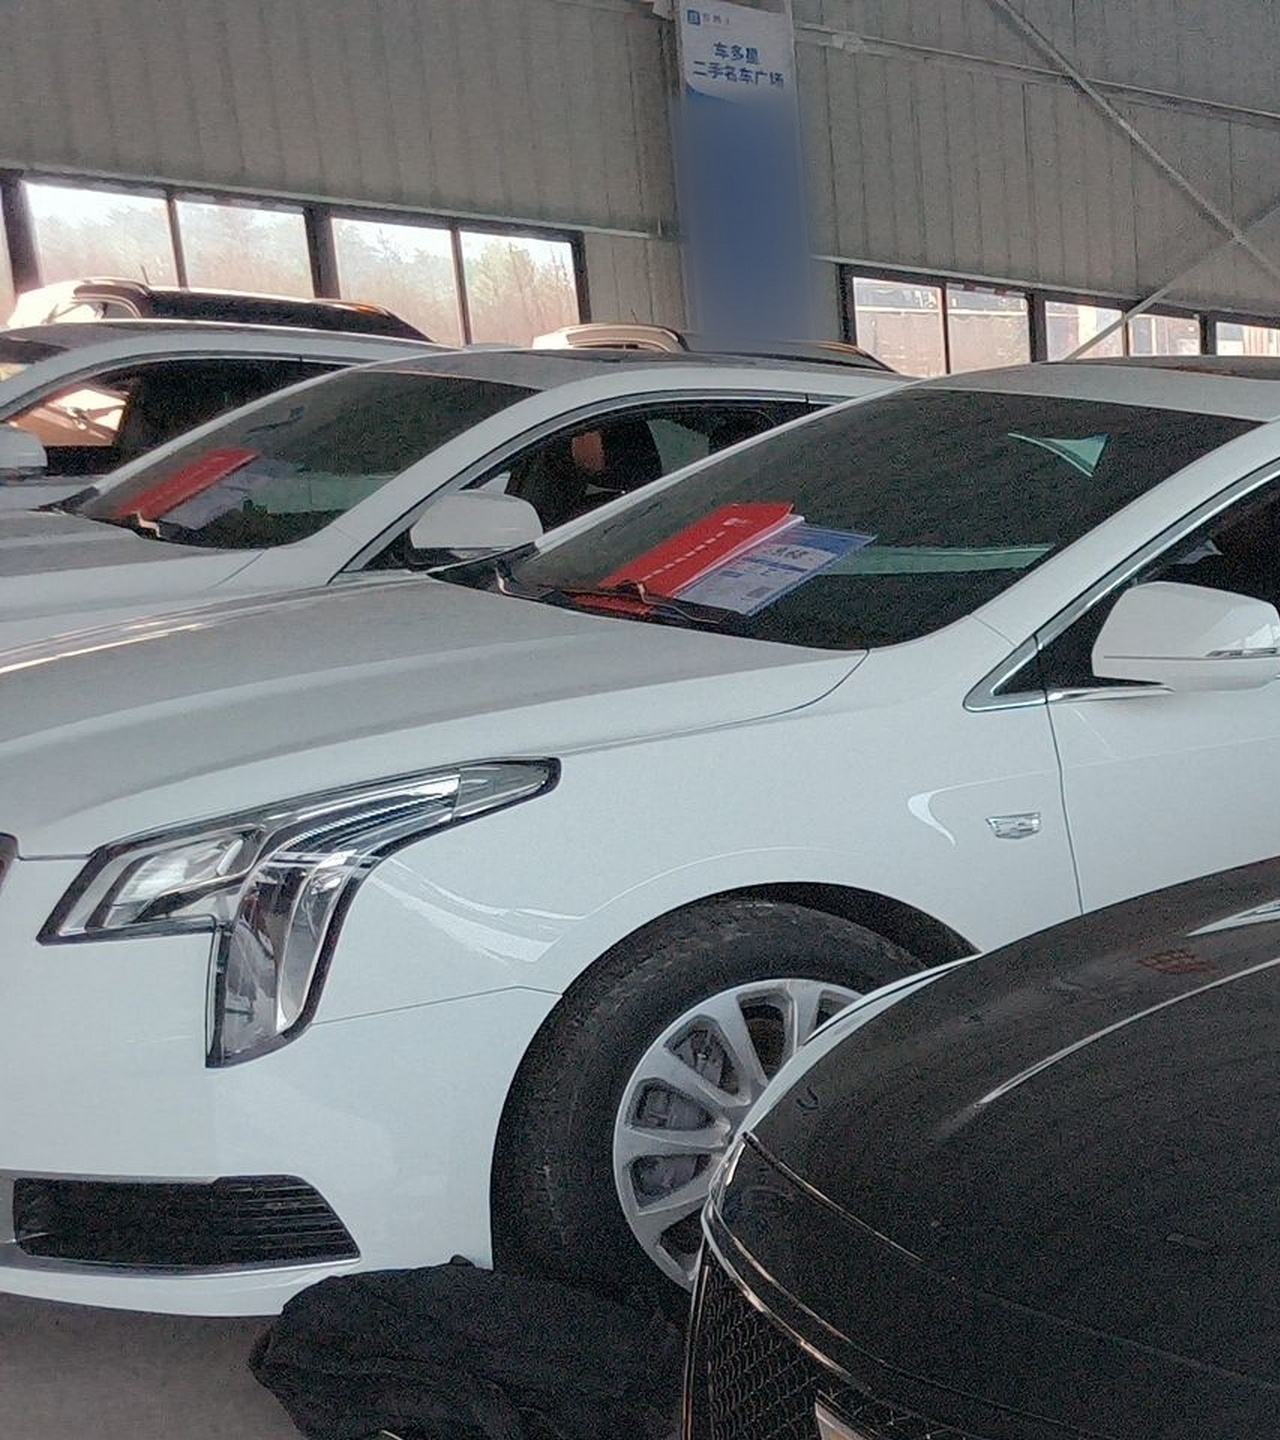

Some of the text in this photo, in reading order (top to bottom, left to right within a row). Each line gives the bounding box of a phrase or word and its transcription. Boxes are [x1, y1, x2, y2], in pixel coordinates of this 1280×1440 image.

[692, 60, 784, 88] 二手名车广场
